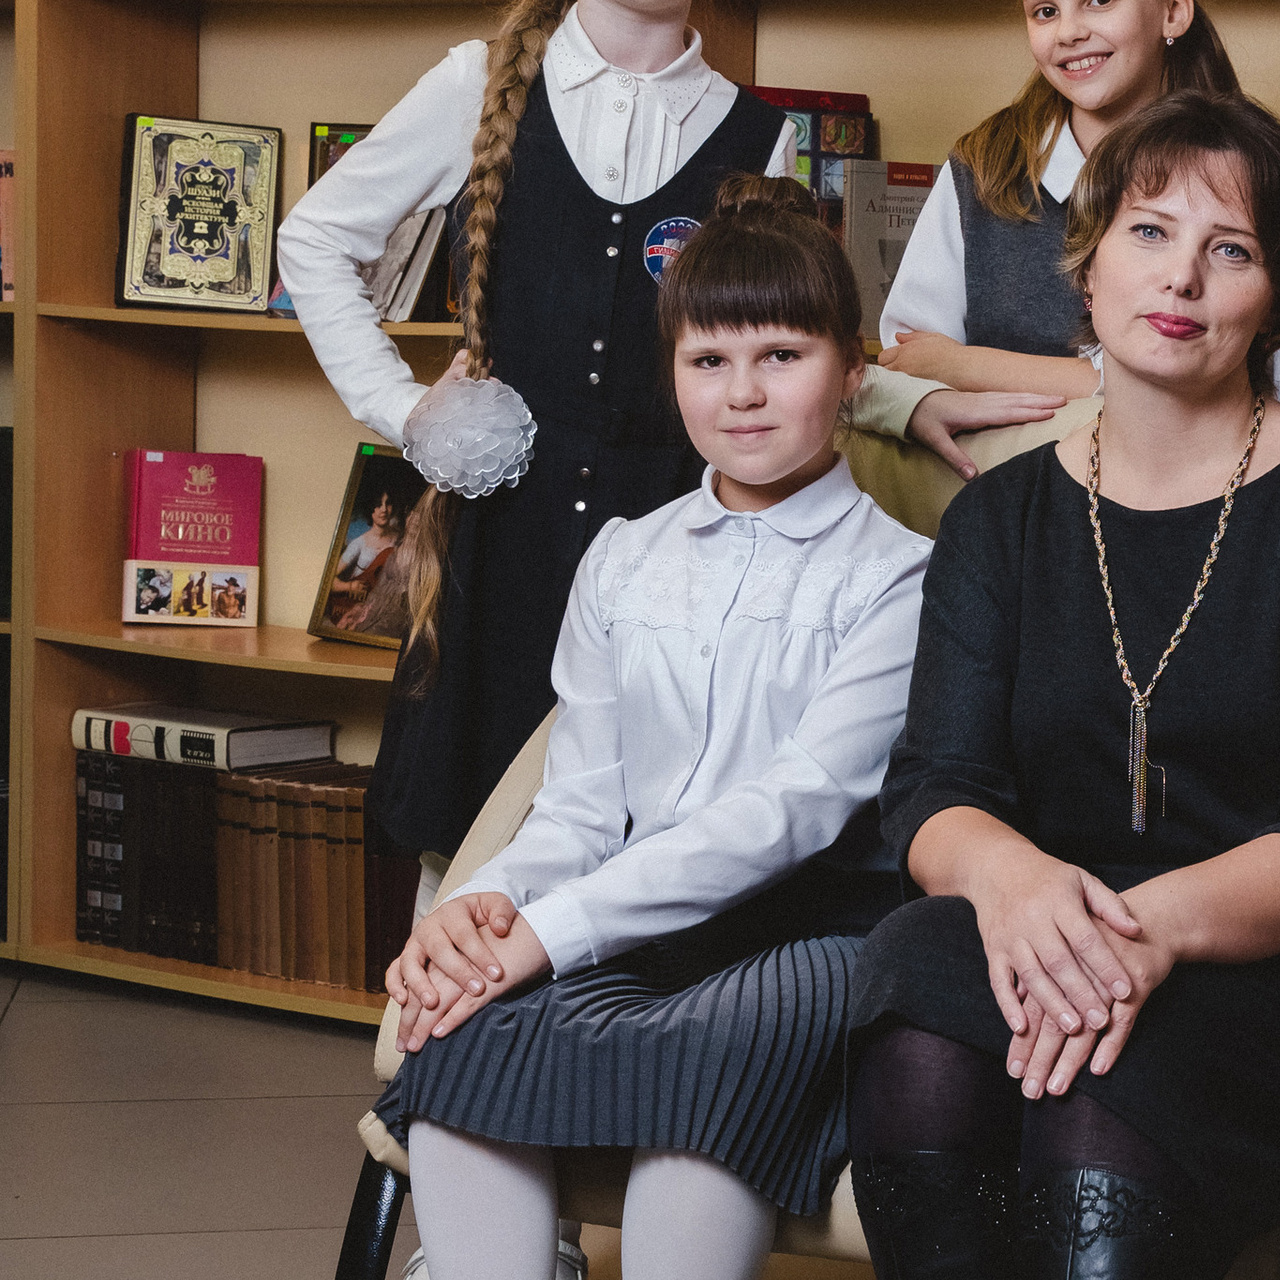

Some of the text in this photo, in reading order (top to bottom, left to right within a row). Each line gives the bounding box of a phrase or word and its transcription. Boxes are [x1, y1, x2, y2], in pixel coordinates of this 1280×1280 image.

[184, 207, 222, 217] ИСТОРИЯ
[161, 510, 234, 526] МИРОВОЕ
[161, 524, 232, 544] КИНО
